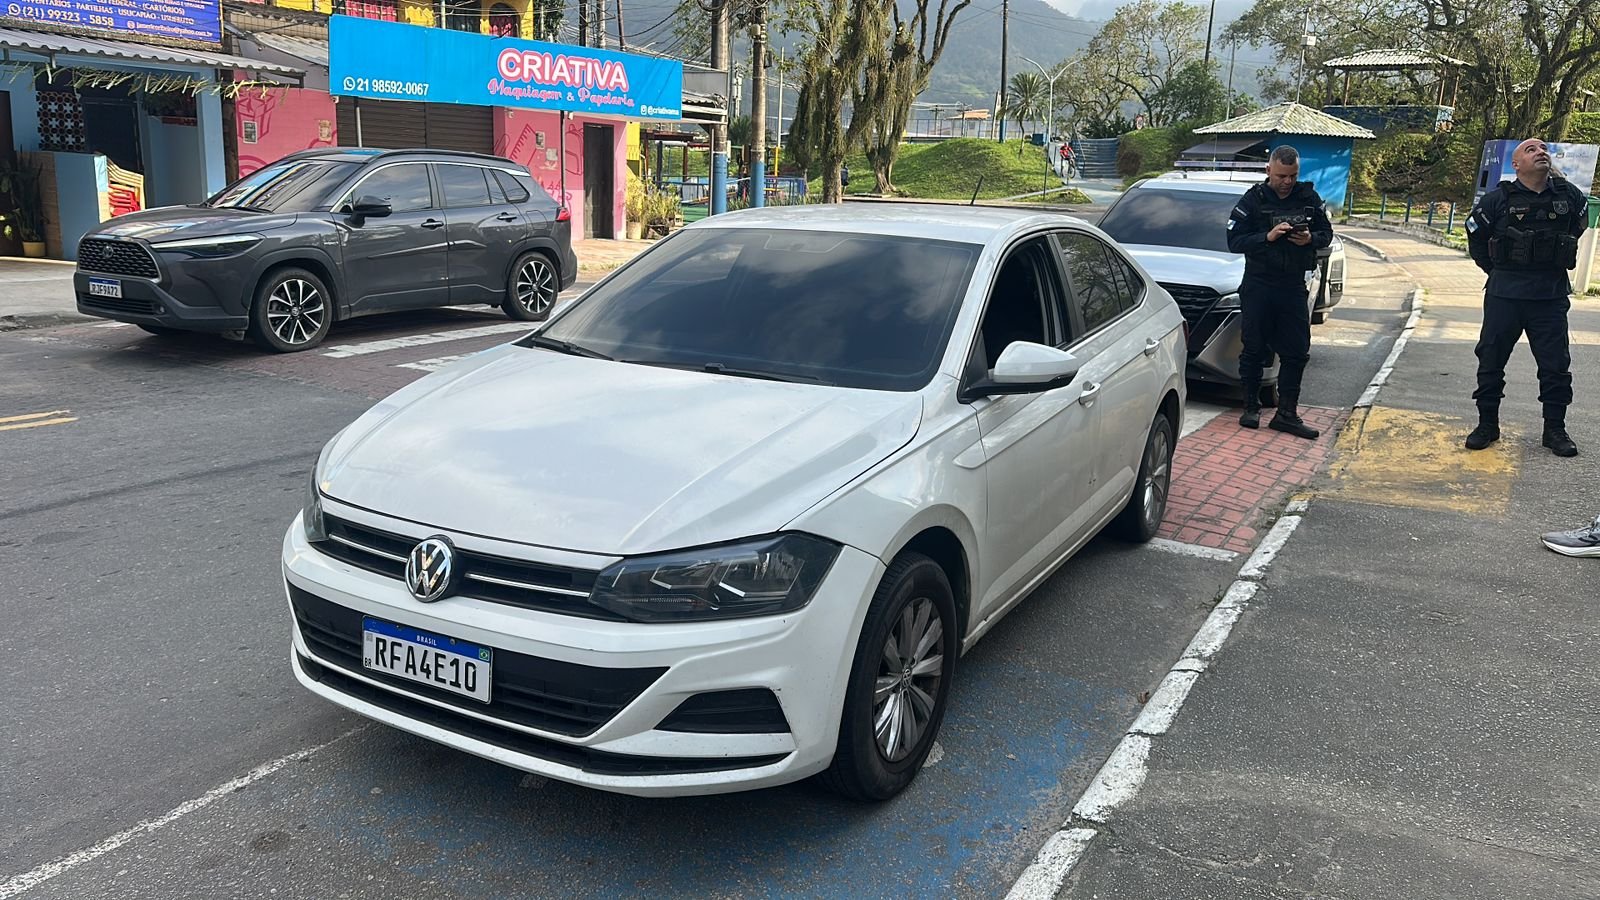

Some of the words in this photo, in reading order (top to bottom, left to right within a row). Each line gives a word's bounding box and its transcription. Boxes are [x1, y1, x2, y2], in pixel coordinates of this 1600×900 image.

[22, 6, 44, 19] (21)
[47, 9, 80, 22] 99323
[89, 14, 114, 26] 5858
[76, 2, 113, 14] PARTILHAS
[498, 49, 629, 92] CRIATIVA
[356, 77, 370, 92] 21
[372, 79, 430, 96] 98592-0067
[487, 78, 562, 102] Maquiagem
[566, 92, 575, 102] &
[577, 87, 635, 107] Papelaria
[416, 635, 438, 646] BRASIL
[364, 657, 372, 667] BR
[375, 637, 477, 692] RFA4E10
